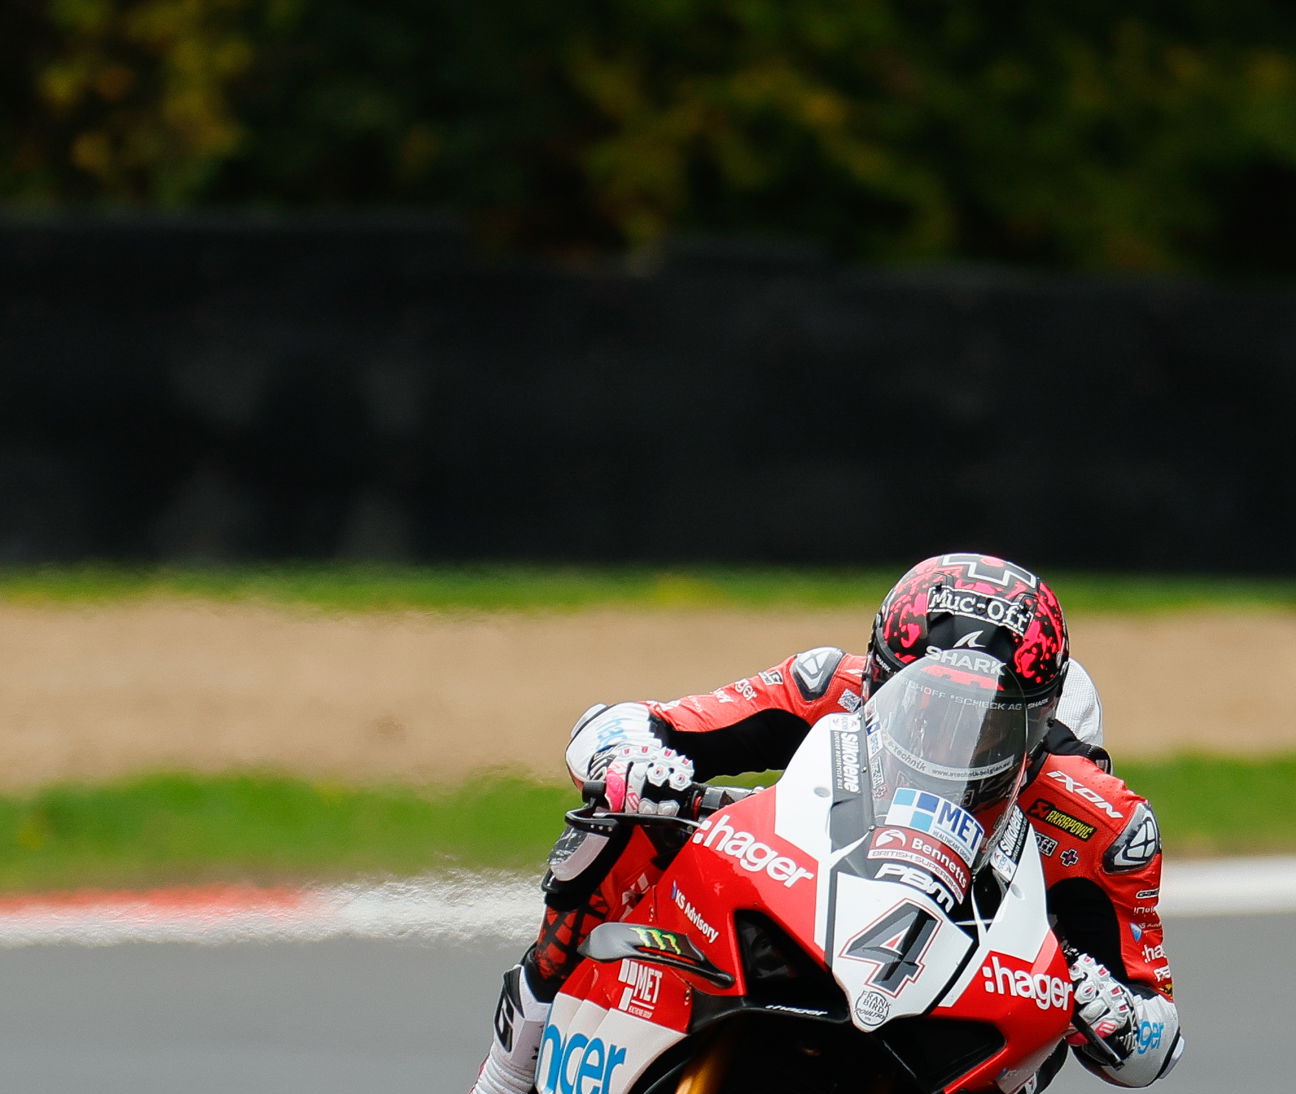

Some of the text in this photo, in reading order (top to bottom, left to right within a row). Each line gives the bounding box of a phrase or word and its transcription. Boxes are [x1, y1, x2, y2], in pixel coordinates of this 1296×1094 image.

[925, 645, 1006, 677] SHARK
[937, 801, 984, 851] MET
[871, 850, 913, 861] BRITISH
[911, 838, 967, 889] Bennetts
[684, 902, 720, 944] Advisory
[838, 897, 944, 999] 4
[634, 963, 663, 1003] MET
[862, 990, 892, 1009] FRANK
[862, 1000, 885, 1014] BIRD
